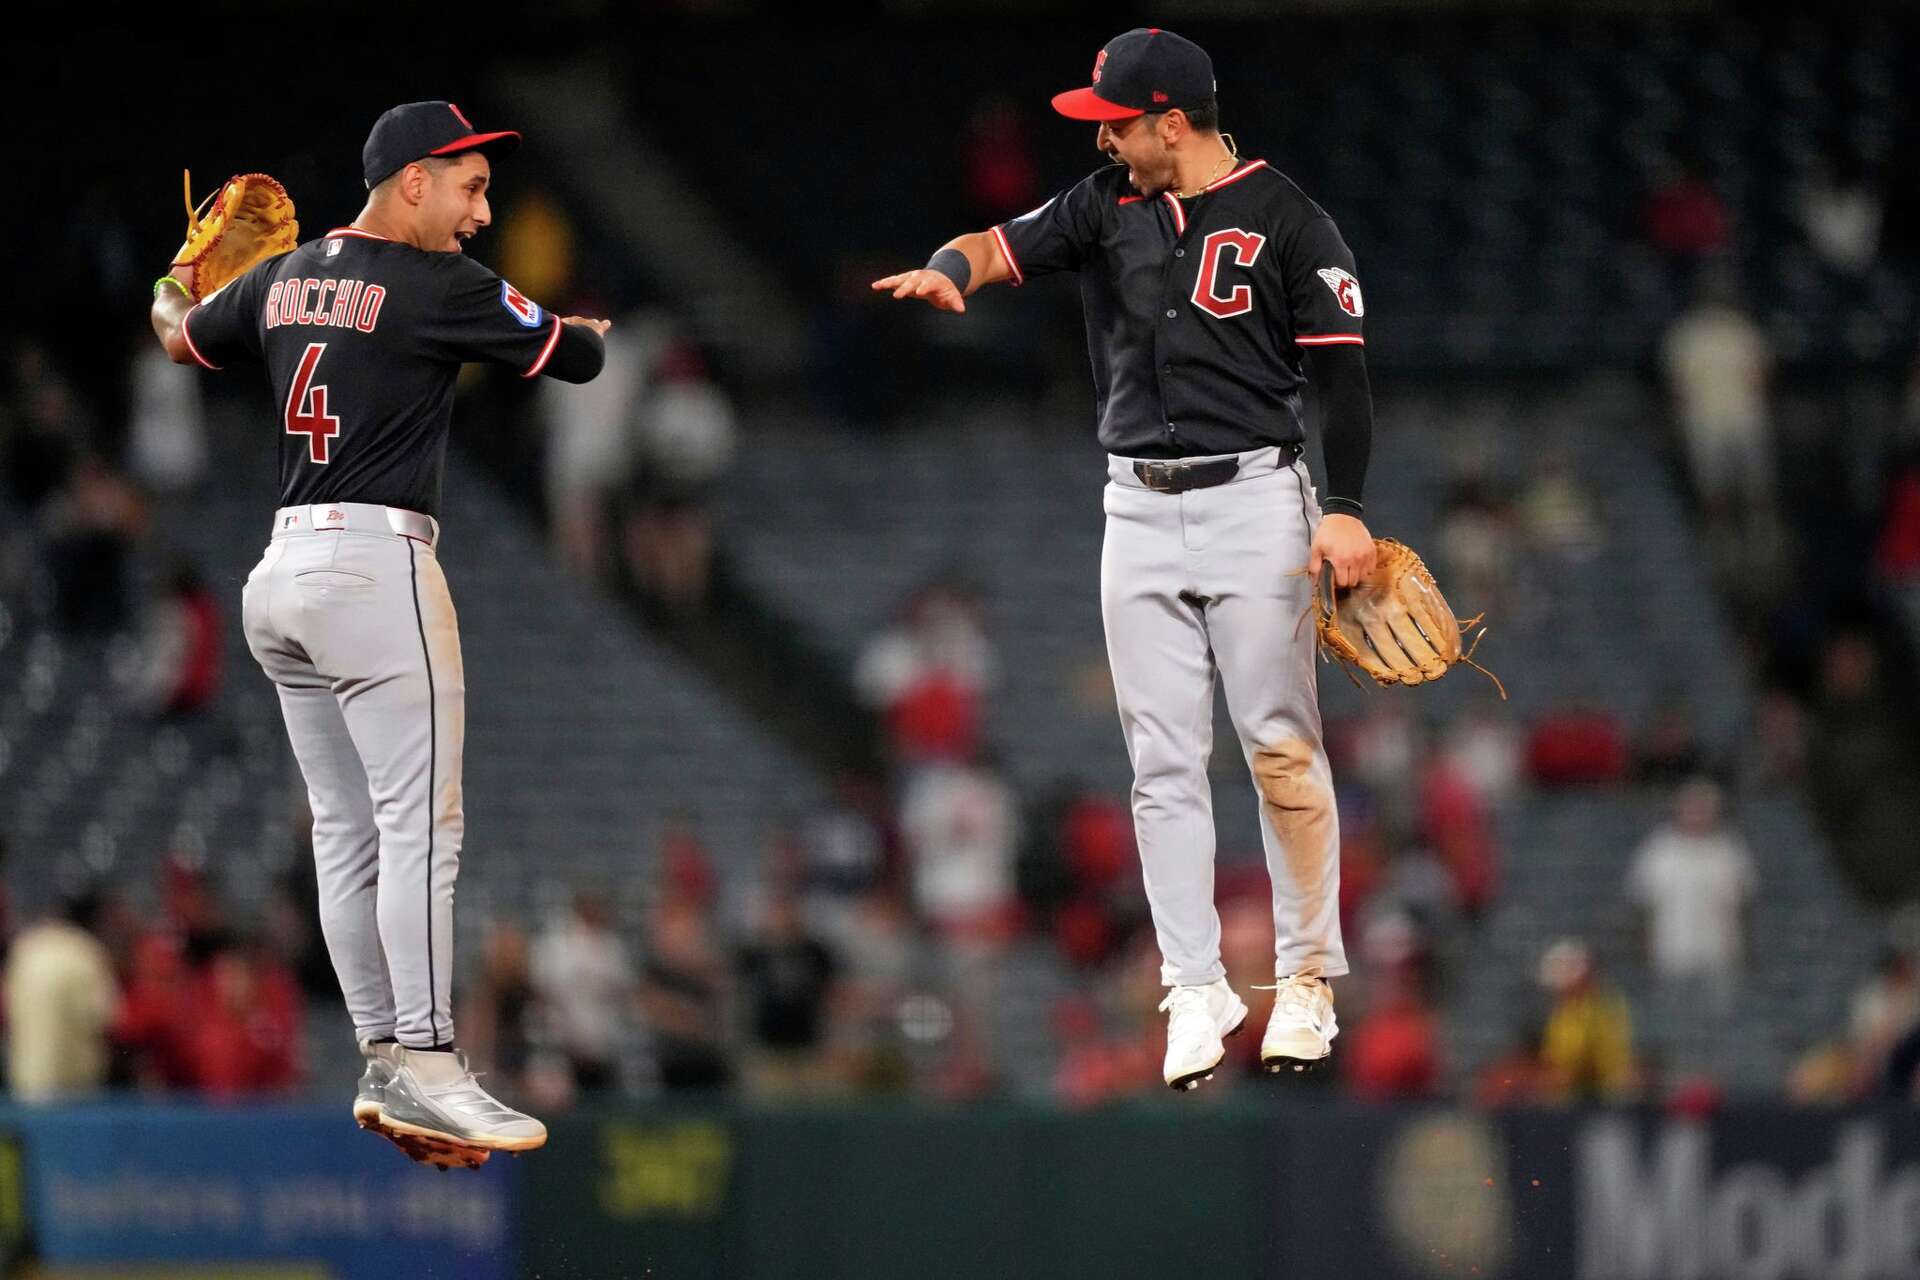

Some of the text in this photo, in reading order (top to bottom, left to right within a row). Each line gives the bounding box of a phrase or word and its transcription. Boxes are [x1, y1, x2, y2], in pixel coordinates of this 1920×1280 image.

[266, 278, 386, 333] ROCCHIO
[1191, 227, 1267, 319] C
[285, 342, 340, 464] 4
